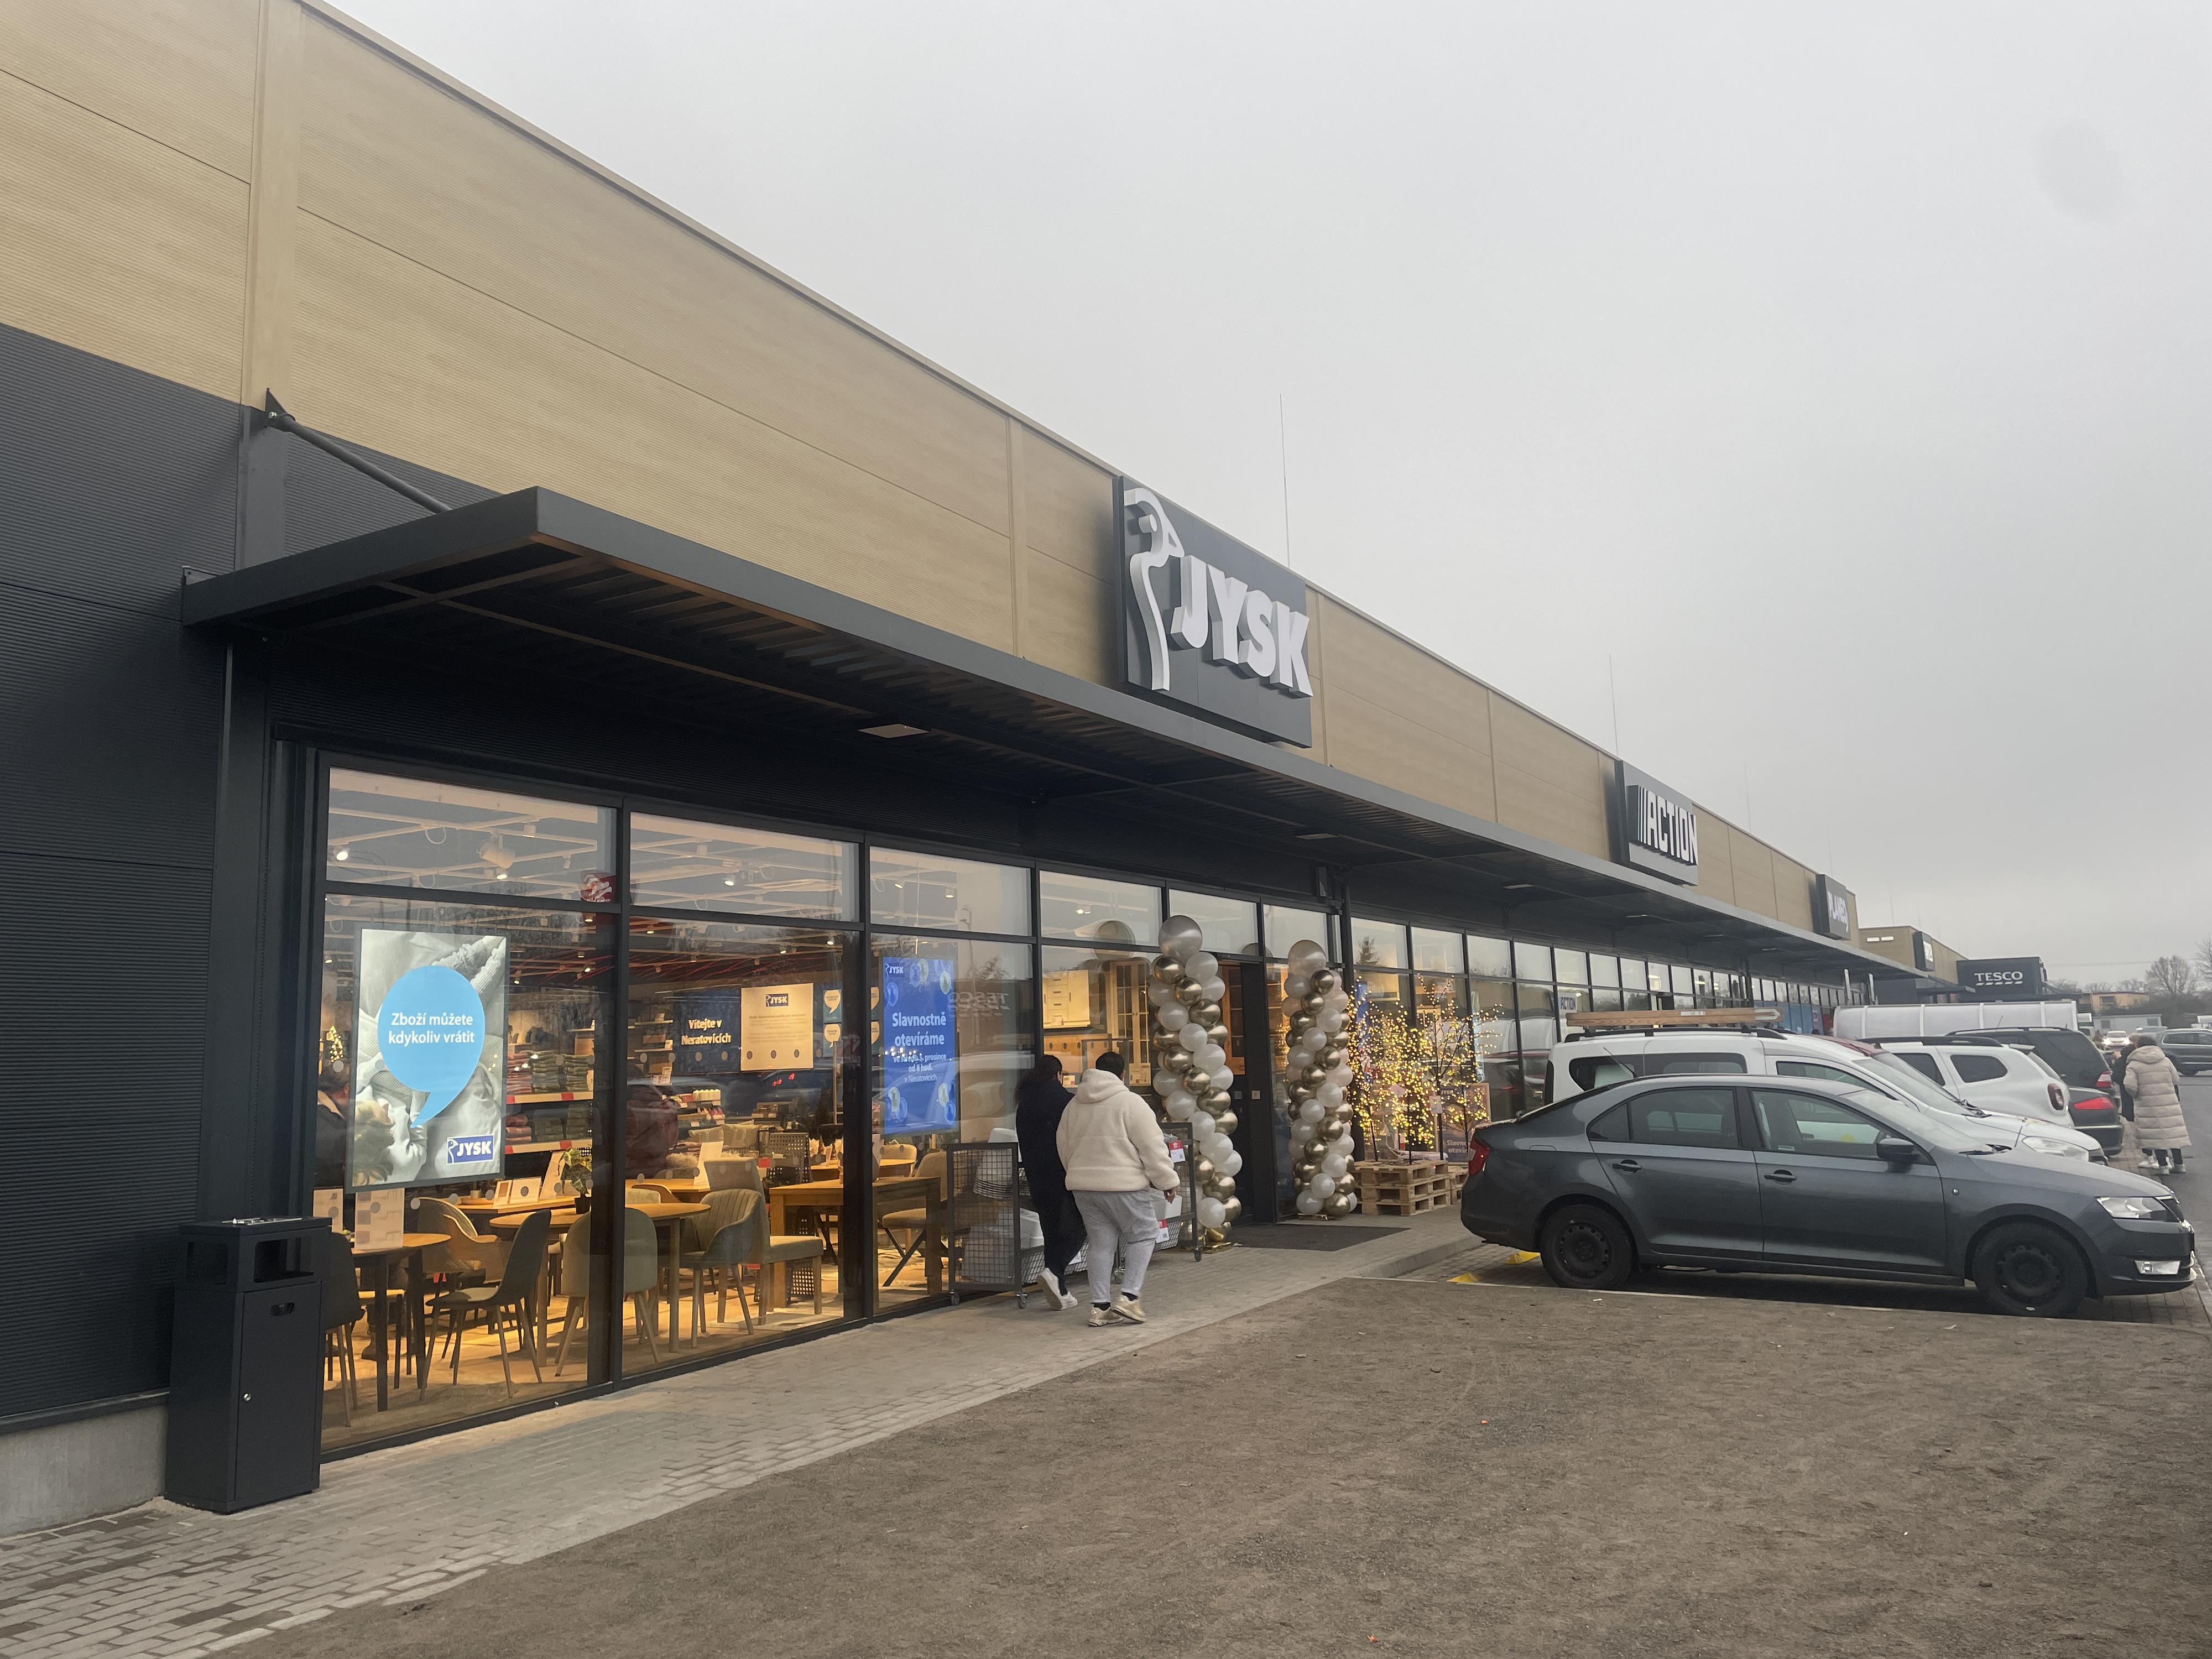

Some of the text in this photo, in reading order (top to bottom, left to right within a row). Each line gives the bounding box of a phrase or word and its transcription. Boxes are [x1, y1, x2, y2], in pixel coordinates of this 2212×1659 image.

[1170, 555, 1313, 697] JYSK
[1646, 790, 1698, 865] ACTION
[1974, 971, 2023, 982] TESCO
[770, 996, 787, 1004] JYSK
[391, 1012, 473, 1025] Zboží můžete
[688, 1018, 722, 1031] Vítejte v
[892, 1011, 946, 1027] Slavnostně
[388, 1030, 475, 1047] kdykoliv vrátit
[681, 1032, 732, 1046] Neratovicích
[894, 1031, 945, 1047] otevíráme
[925, 1053, 947, 1063] prosince
[921, 1062, 933, 1071] hod.
[457, 1141, 492, 1157] JYSK
